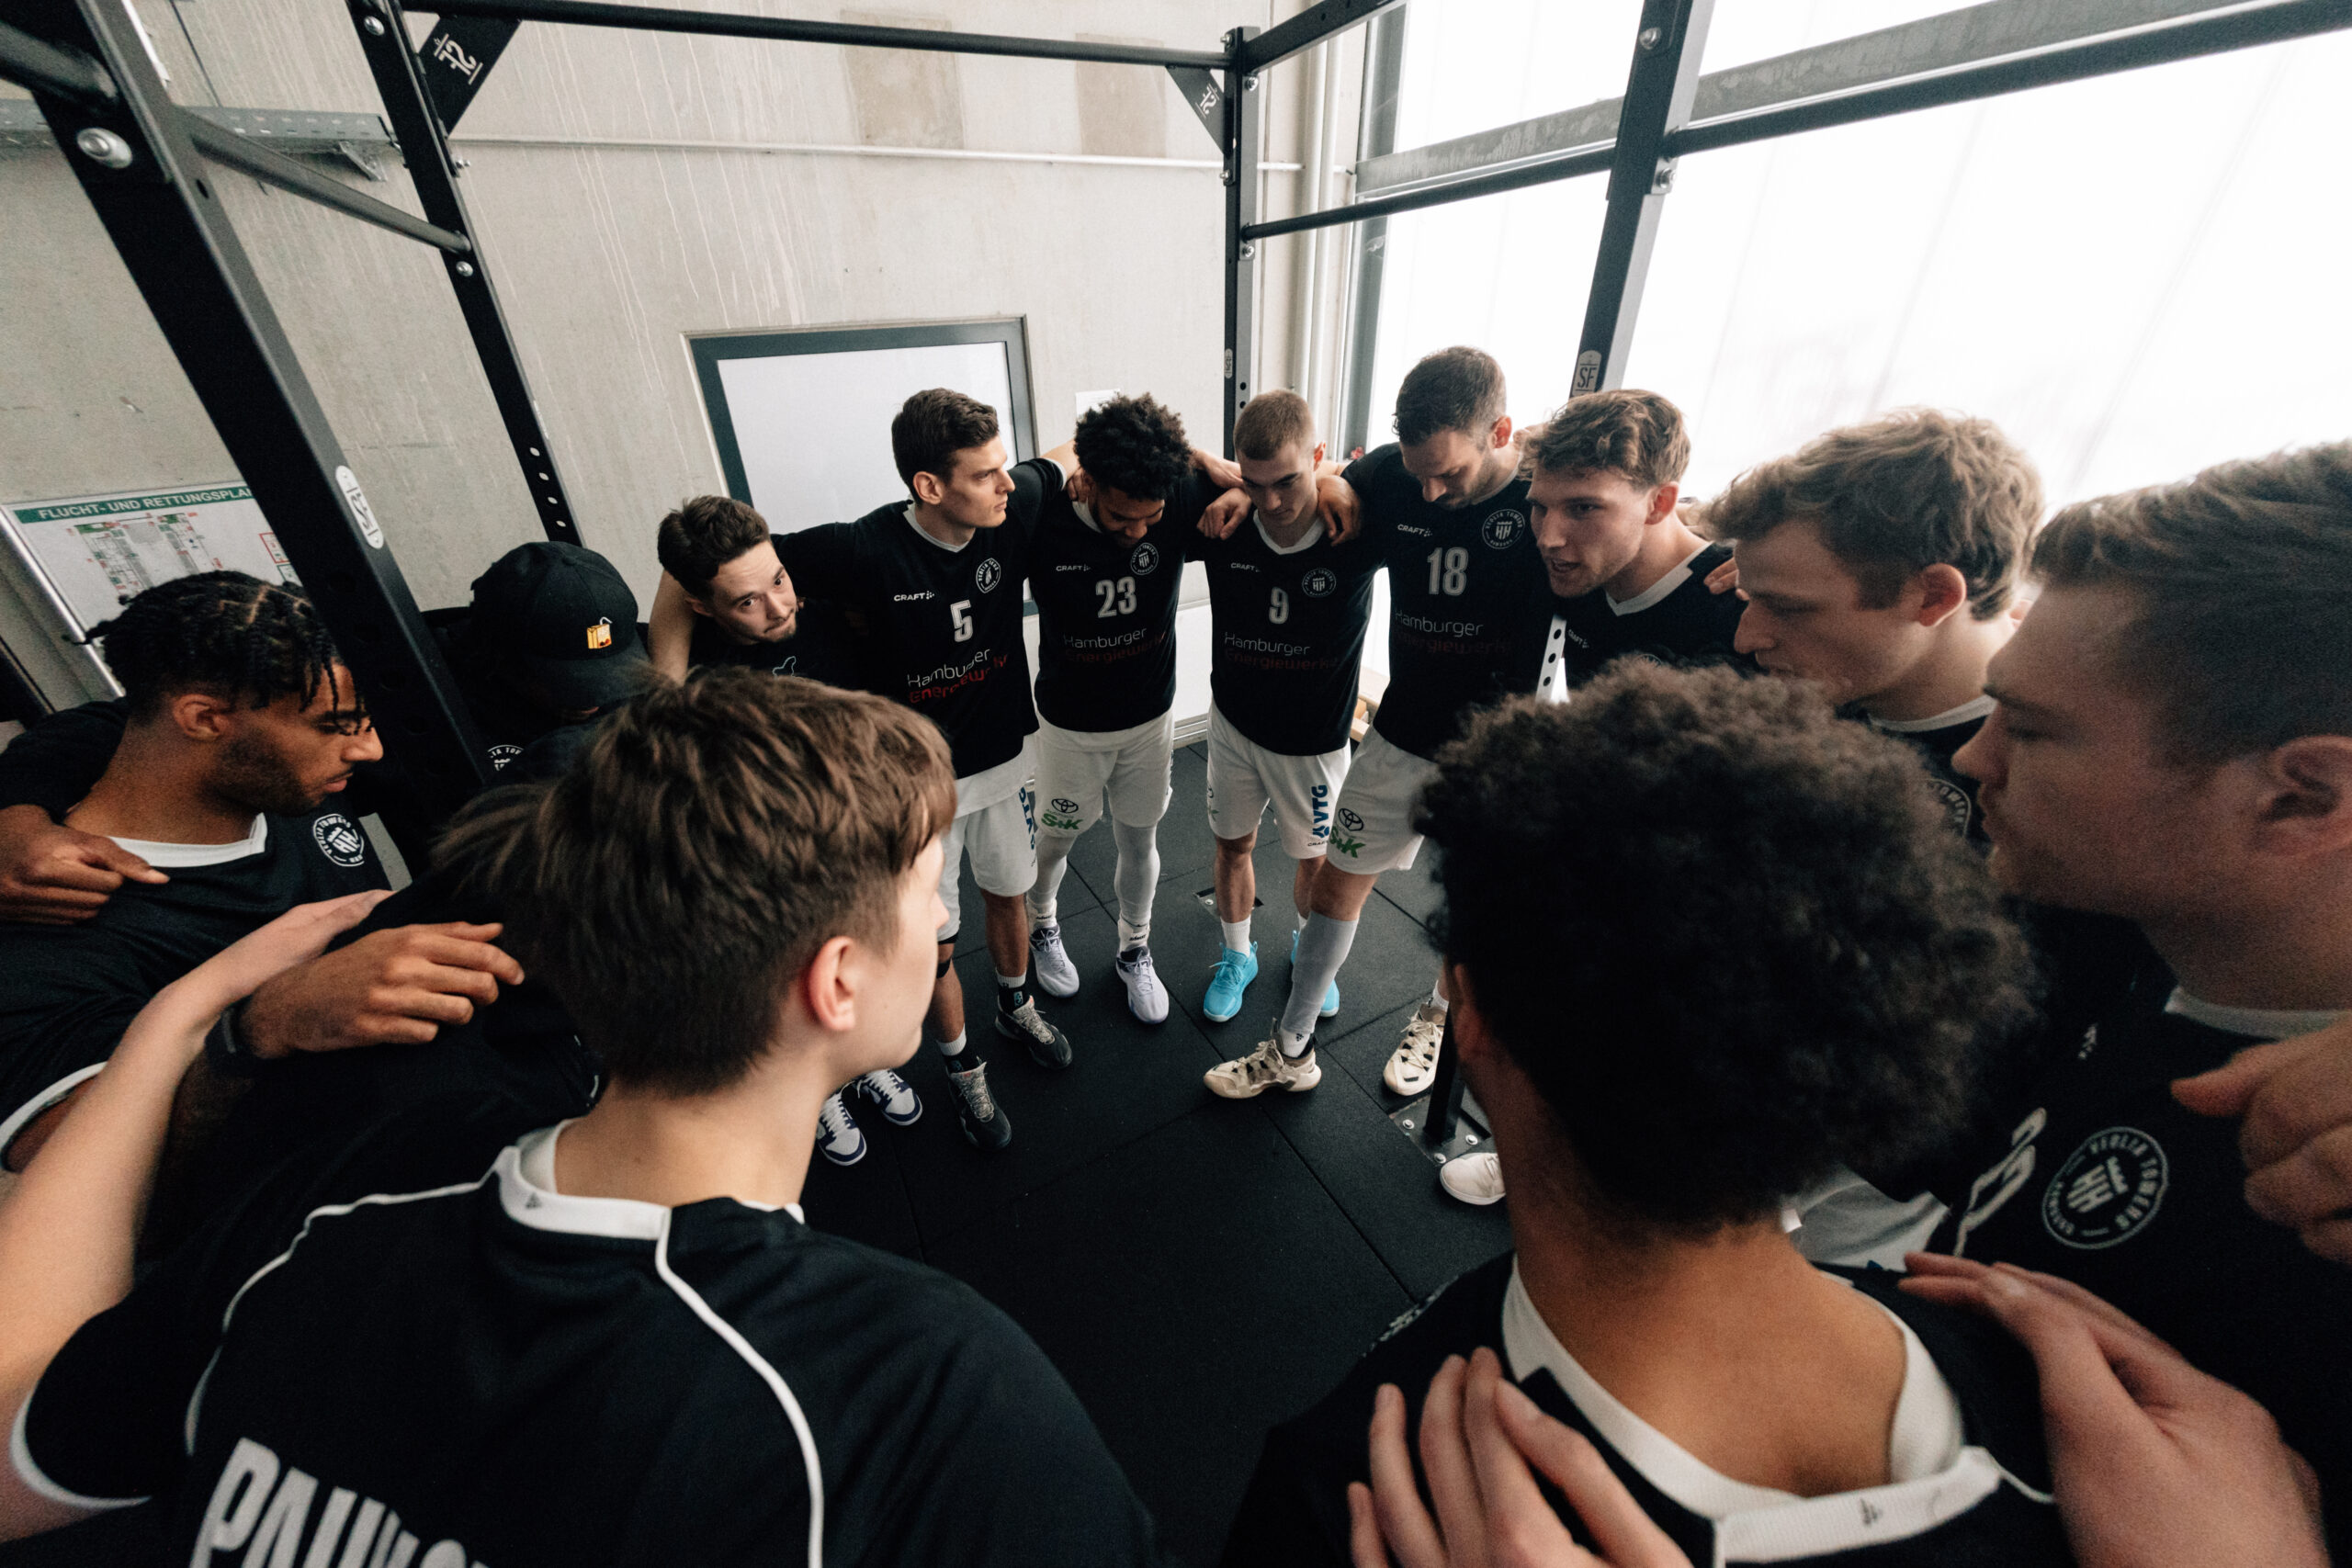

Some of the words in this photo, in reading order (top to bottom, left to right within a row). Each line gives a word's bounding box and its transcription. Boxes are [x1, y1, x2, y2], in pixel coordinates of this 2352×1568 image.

[1577, 366, 1597, 389] SF
[37, 503, 107, 520] FLUCHT-
[107, 499, 141, 513] UND
[1397, 523, 1425, 536] CRAFT
[1231, 562, 1255, 570] CRAFT
[1427, 546, 1469, 596] 18
[894, 592, 926, 602] CRAFT
[1095, 576, 1137, 618] 23
[1269, 587, 1289, 625] 9
[950, 599, 974, 643] 5
[1395, 609, 1485, 638] Hamburger
[1062, 627, 1148, 649] Hamburger
[1224, 631, 1311, 657] Hamburger
[1311, 784, 1329, 824] VTG
